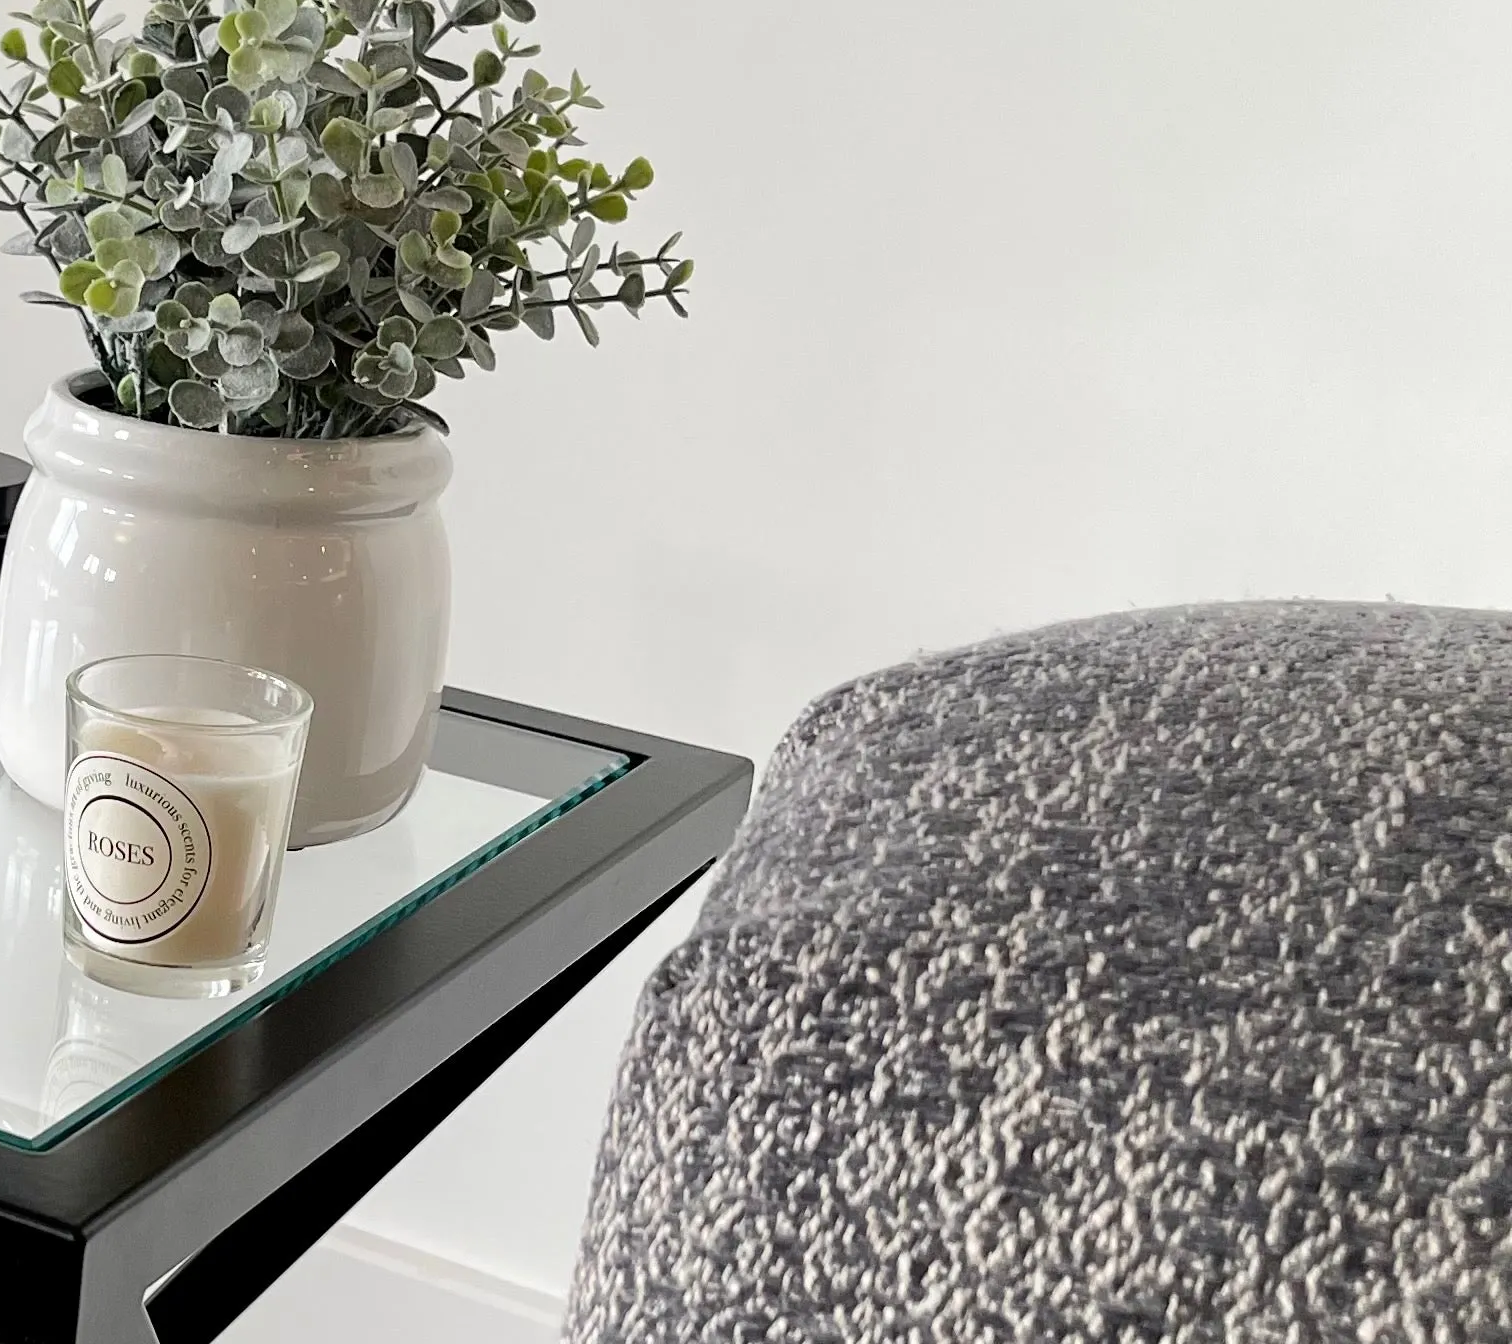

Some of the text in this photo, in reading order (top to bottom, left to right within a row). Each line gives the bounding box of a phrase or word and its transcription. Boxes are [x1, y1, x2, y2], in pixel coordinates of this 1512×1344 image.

[75, 777, 84, 795] of
[82, 769, 112, 792] giving
[125, 772, 183, 822] luxurious
[88, 830, 155, 866] ROSES
[178, 822, 196, 864] scents
[73, 873, 85, 895] the
[180, 867, 198, 887] for
[82, 895, 103, 916] and
[142, 888, 184, 924] elegant
[104, 908, 141, 930] living
